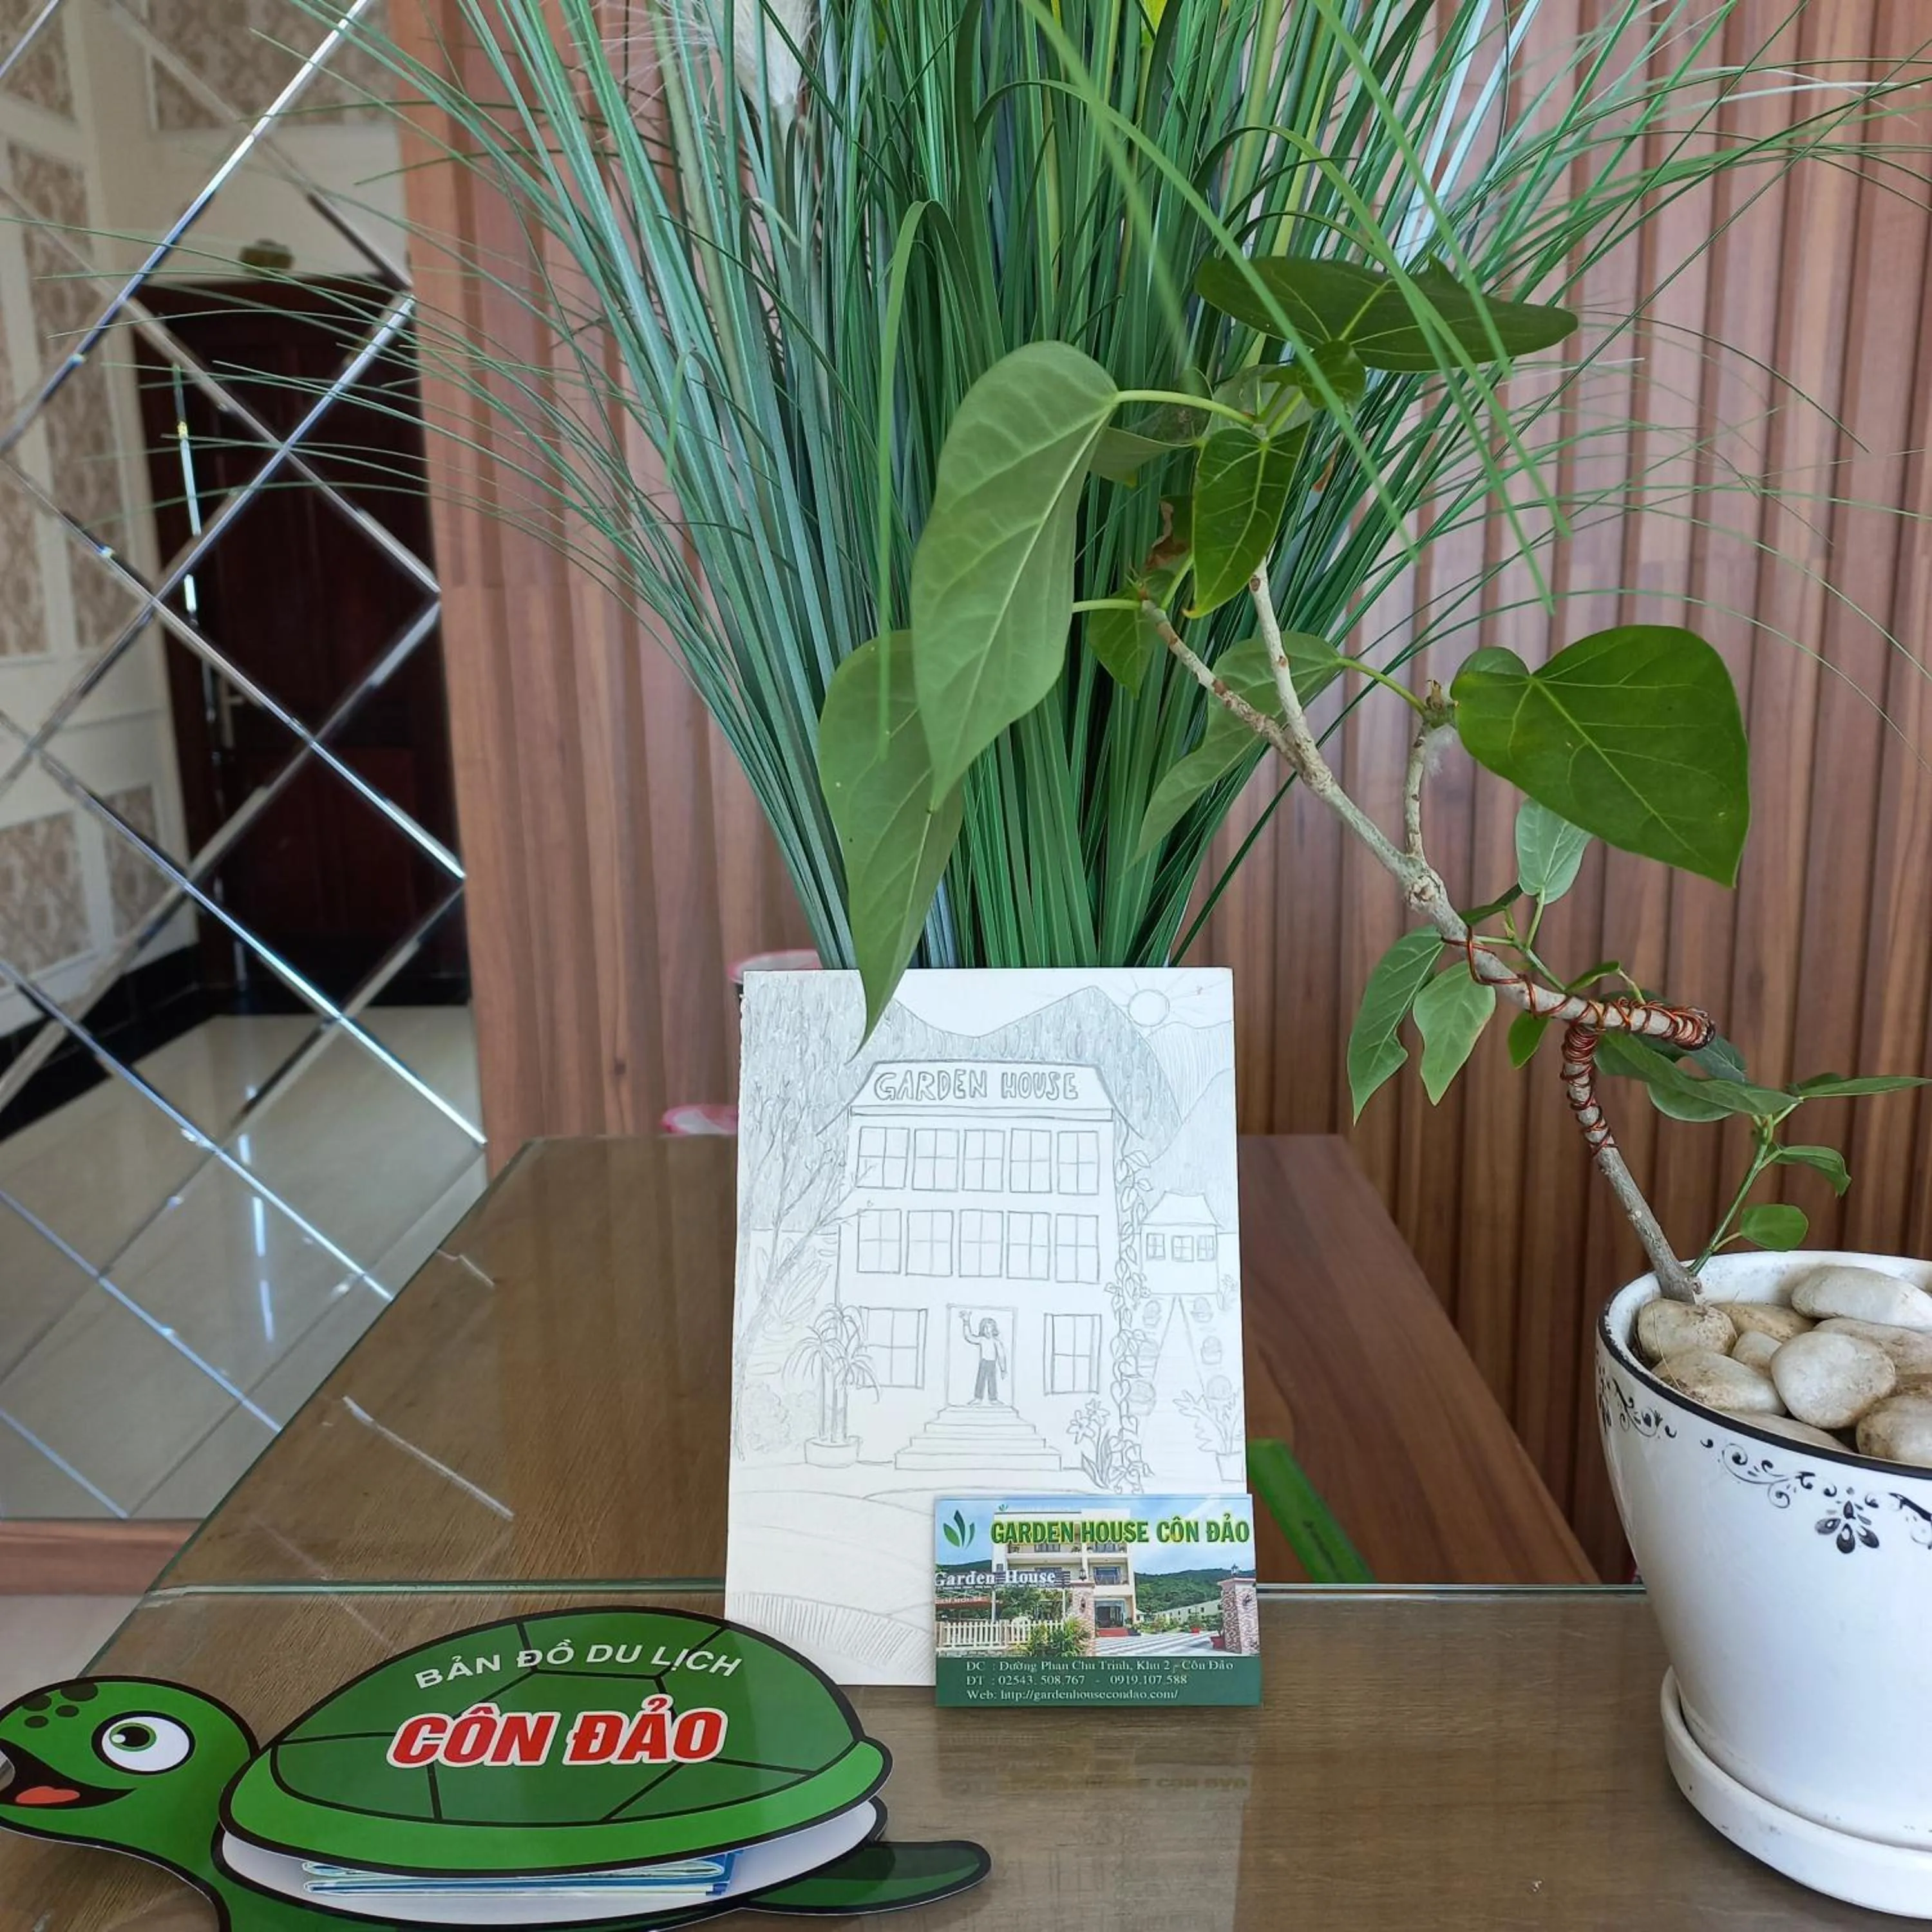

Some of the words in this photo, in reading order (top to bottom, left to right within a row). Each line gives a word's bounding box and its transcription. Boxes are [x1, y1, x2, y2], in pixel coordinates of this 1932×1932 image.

[874, 1069, 988, 1101] GARDEN
[1001, 1071, 1079, 1101] HOUSE
[990, 1520, 1076, 1544] GARDEN
[1081, 1520, 1149, 1544] HOUSE
[1157, 1513, 1202, 1544] CÔN
[1206, 1513, 1250, 1543] ĐẢO
[934, 1571, 995, 1586] Garden
[1005, 1569, 1056, 1584] House
[414, 1654, 502, 1689] BẢN
[516, 1640, 575, 1667] ĐỒ
[585, 1644, 642, 1663] DU
[650, 1645, 743, 1676] LỊCH
[1041, 1661, 1069, 1670] Phan
[1072, 1661, 1095, 1670] Chu
[1137, 1660, 1160, 1670] Khu
[1164, 1660, 1170, 1670] 2
[1182, 1660, 1206, 1670] Côn
[1109, 1675, 1188, 1685] 0919.107.588
[967, 1689, 997, 1700] Web:
[386, 1702, 562, 1768] CÔN
[563, 1694, 728, 1765] ĐẢO
